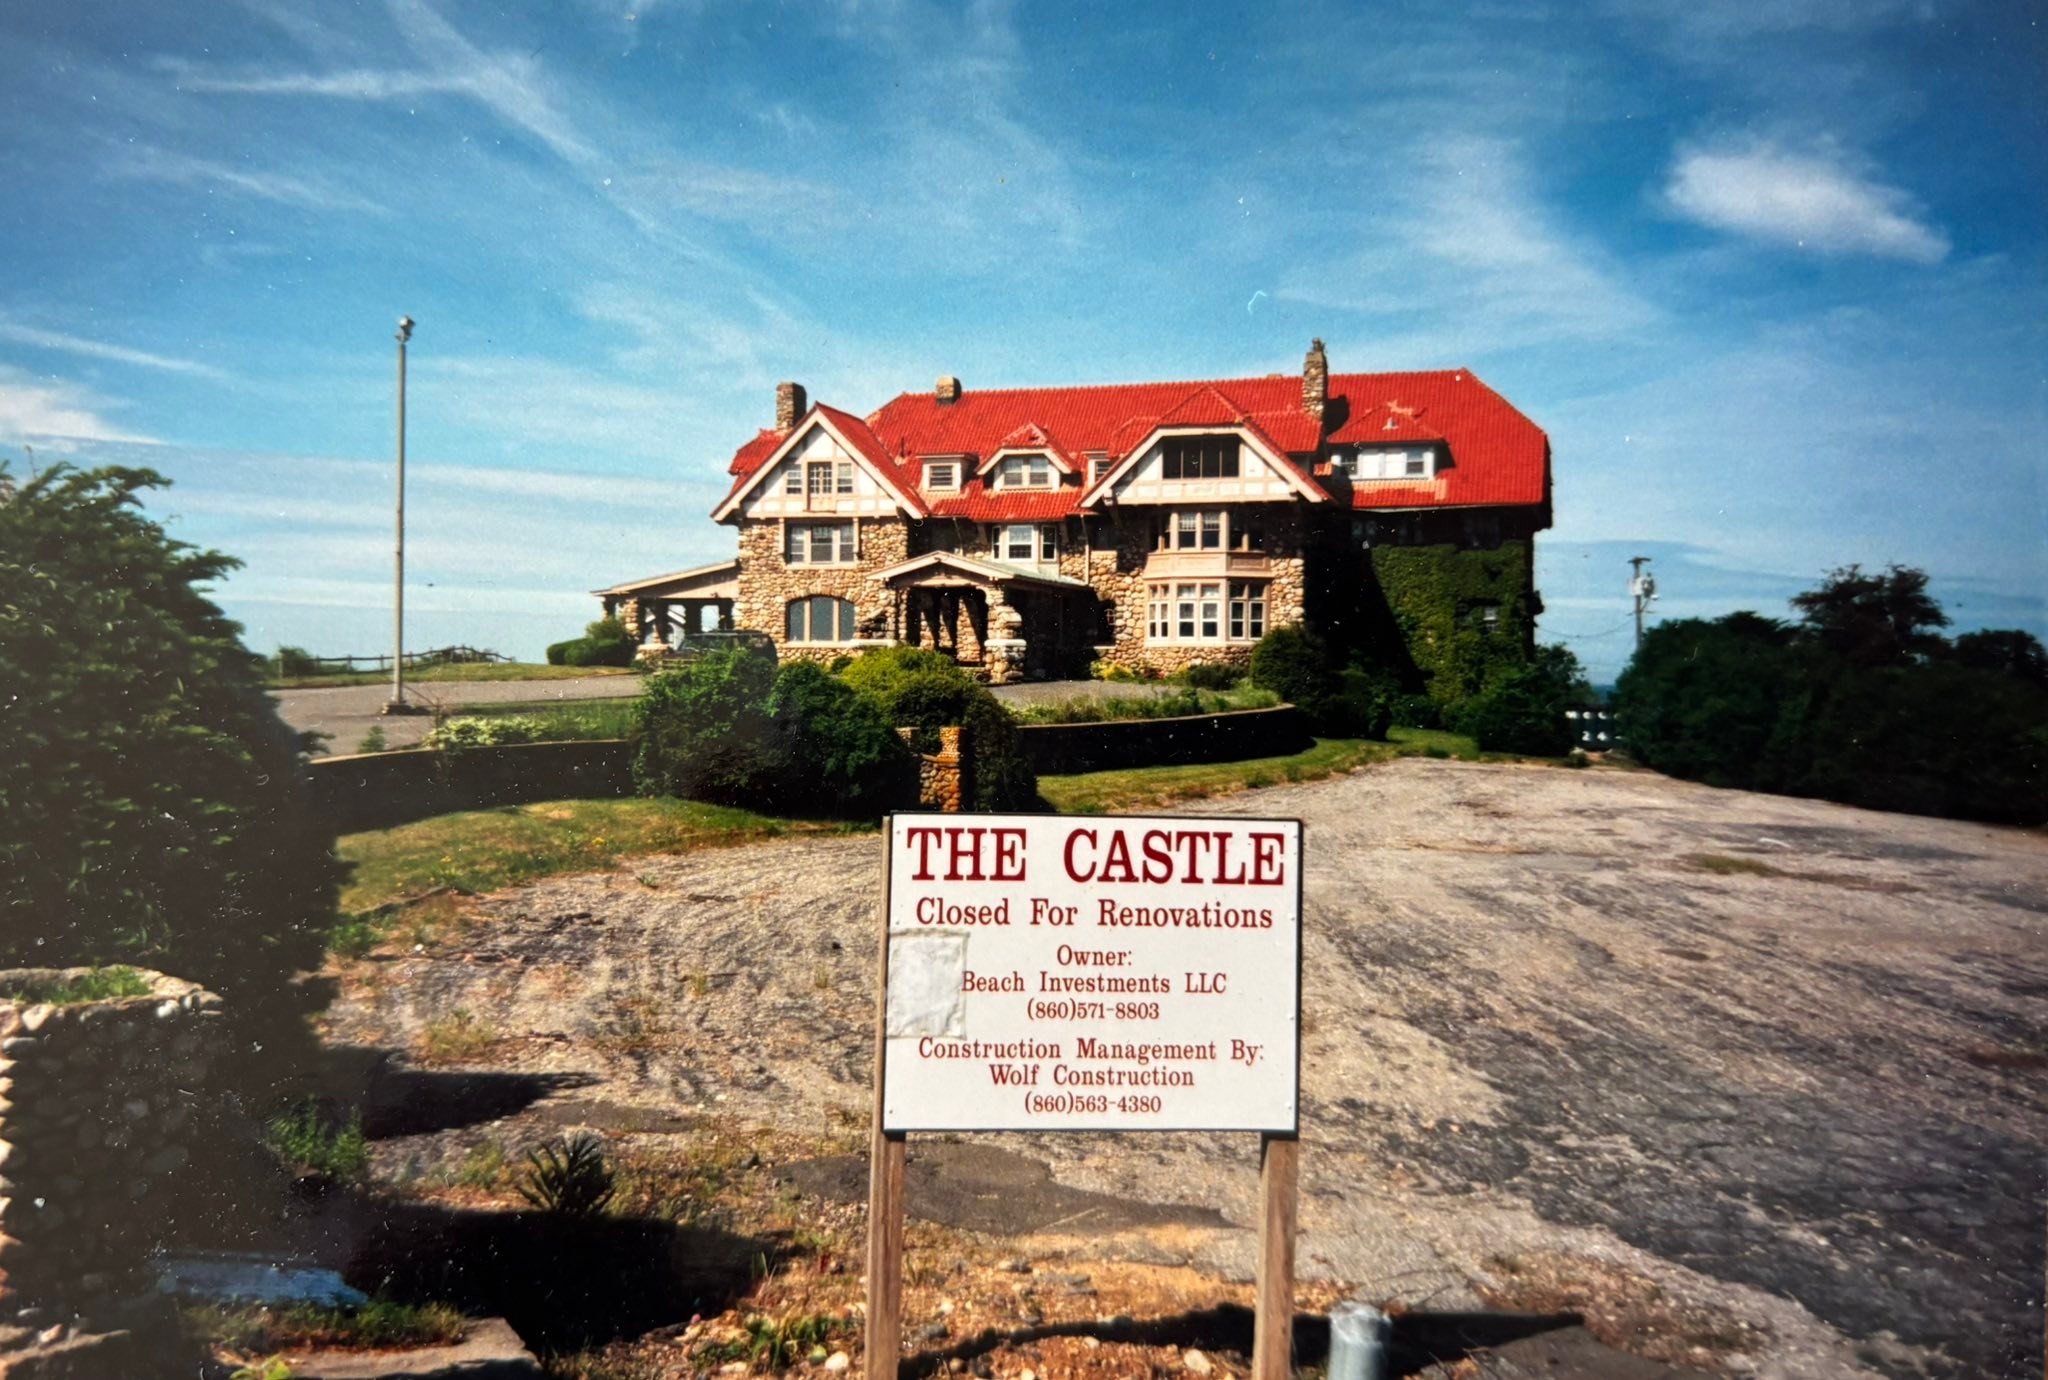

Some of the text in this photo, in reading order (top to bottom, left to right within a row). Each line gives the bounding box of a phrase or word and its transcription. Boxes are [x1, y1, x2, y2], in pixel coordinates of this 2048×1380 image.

[907, 827, 1285, 886] THE CASTLE
[916, 897, 1273, 928] Closed For Renovations
[1057, 944, 1133, 966] Owner:
[962, 971, 1227, 994] Beach Investments LLC
[1027, 998, 1159, 1019] (860)571-8803
[919, 1037, 1264, 1066] Construction Management By:
[989, 1064, 1194, 1086] Wolf Construction
[1025, 1091, 1161, 1114] (860)563-4380
